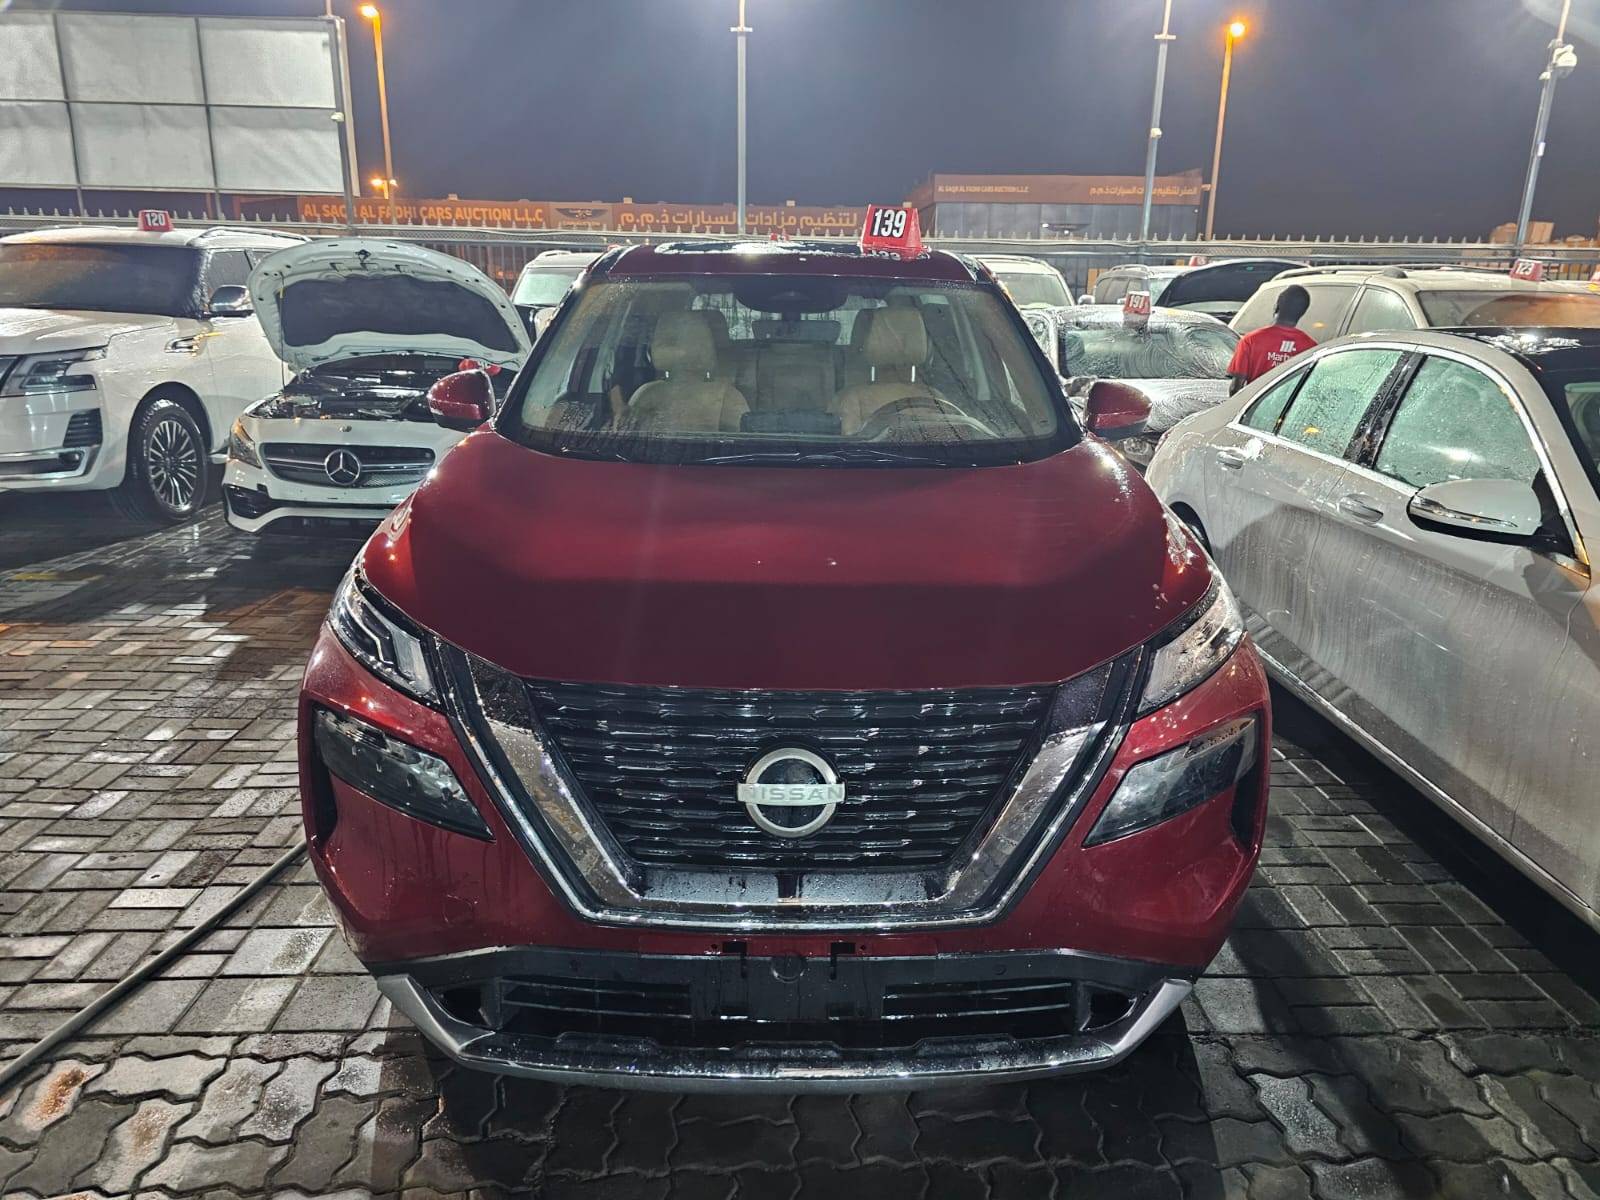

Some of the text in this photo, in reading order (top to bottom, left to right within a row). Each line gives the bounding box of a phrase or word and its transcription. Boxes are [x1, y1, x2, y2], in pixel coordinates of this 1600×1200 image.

[145, 212, 166, 227] 120
[304, 203, 320, 217] AL
[359, 205, 376, 218] AL
[419, 206, 452, 219] CARS
[454, 207, 511, 220] AUCTION
[514, 208, 543, 222] L.L.C
[672, 209, 737, 228] لسيارات
[745, 210, 797, 229] مزادات
[800, 212, 858, 230] لتنظيم
[872, 208, 907, 238] 139
[740, 786, 842, 802] NISSAN
